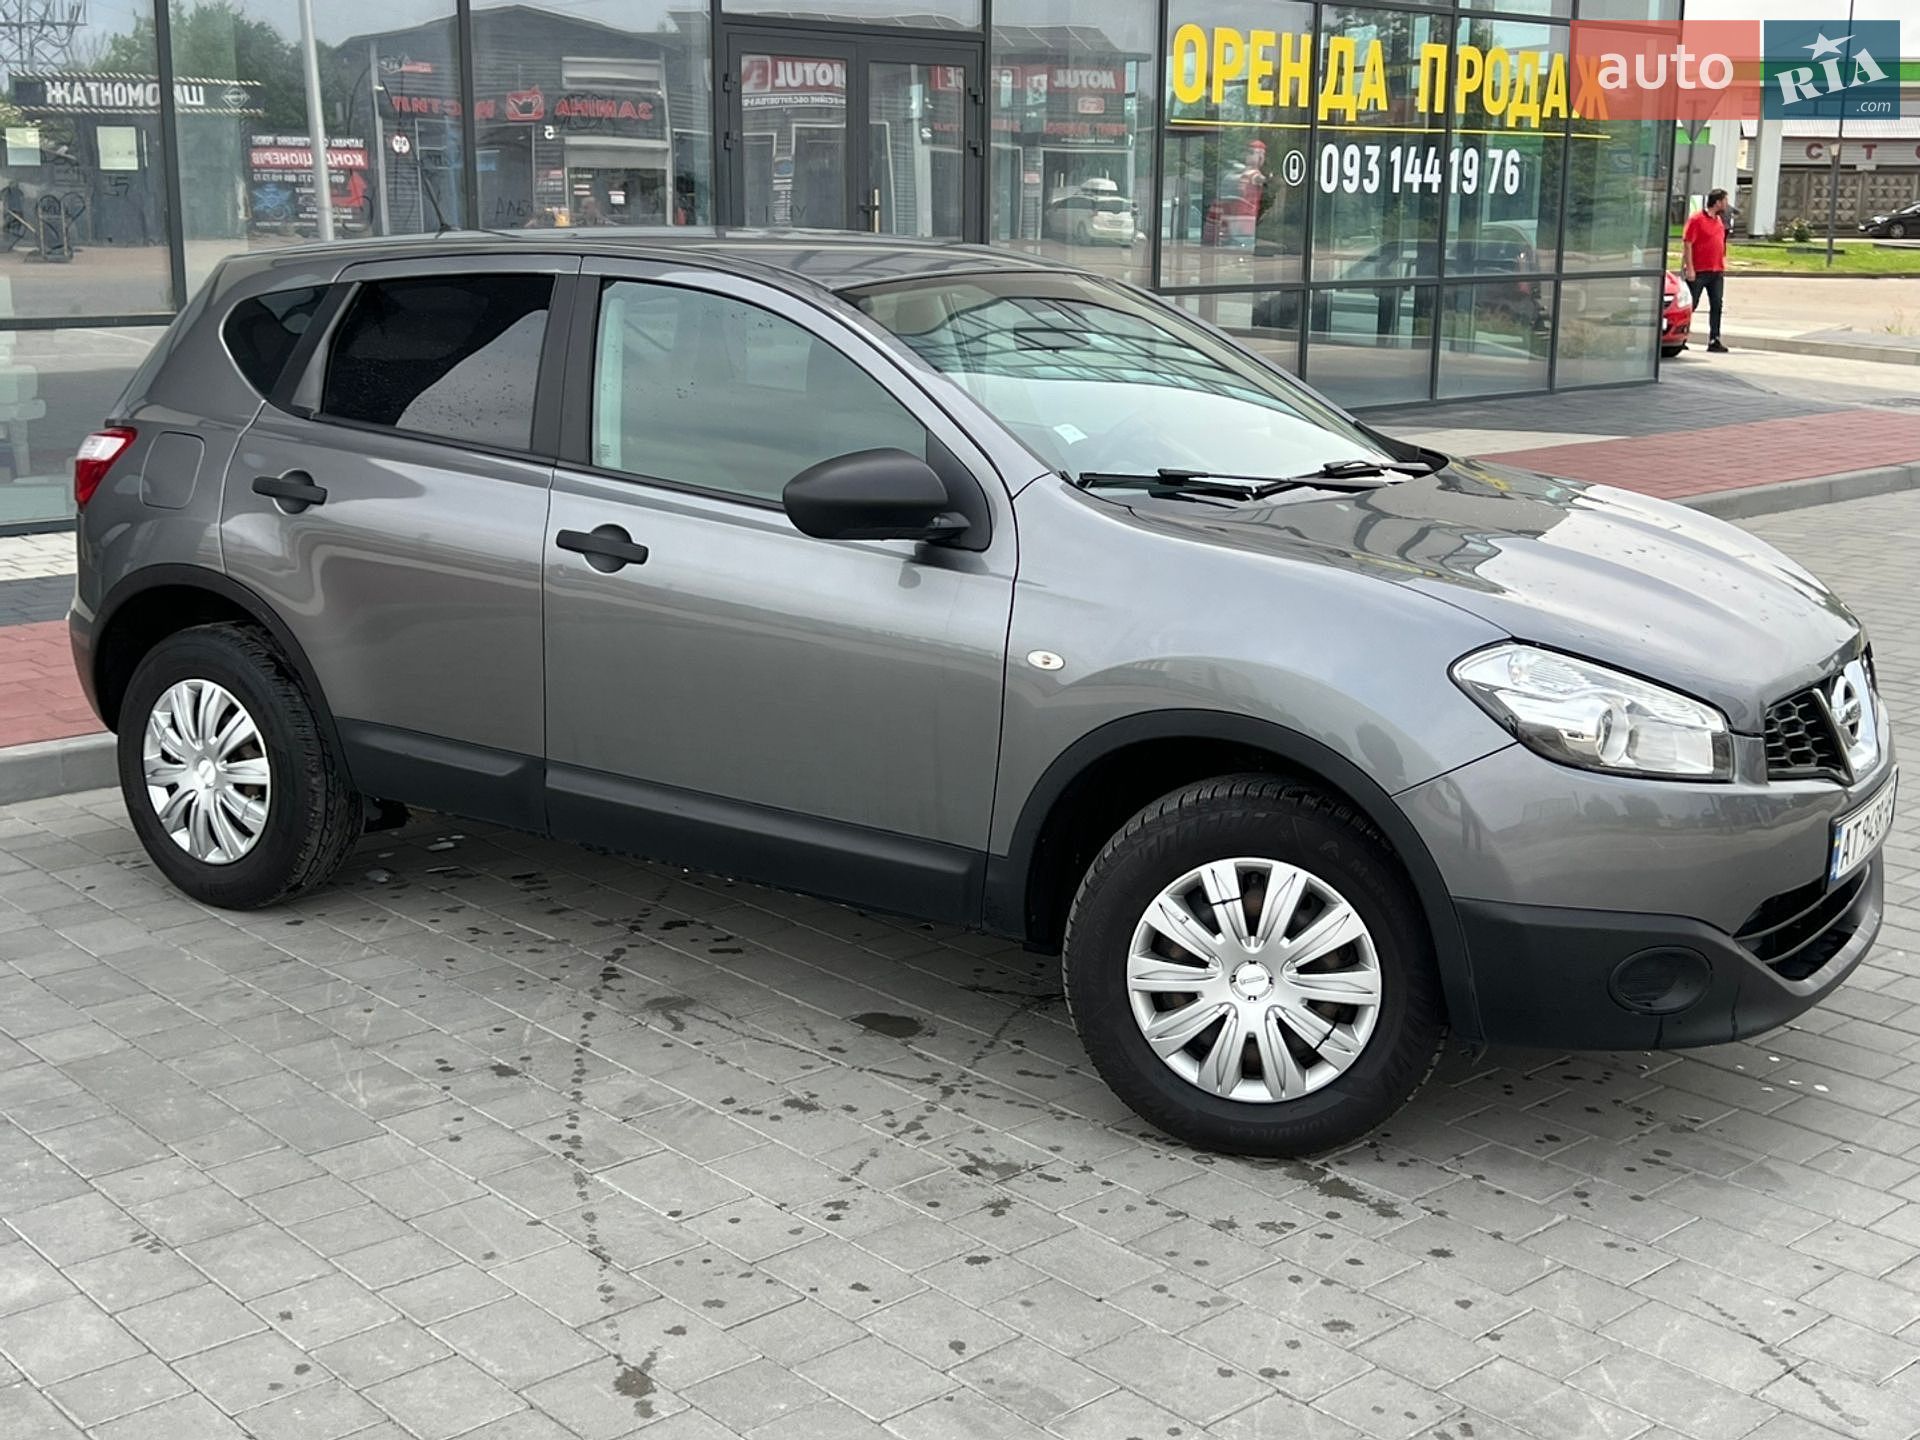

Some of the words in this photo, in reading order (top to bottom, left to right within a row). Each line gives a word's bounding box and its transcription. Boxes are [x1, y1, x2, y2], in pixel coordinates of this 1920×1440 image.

[1173, 23, 1389, 123] ОРЕНДА
[1417, 43, 1610, 129] ПРОДАЖ
[1320, 142, 1380, 194] 093
[1390, 145, 1441, 194] 144
[1450, 148, 1478, 195] 19
[1487, 148, 1521, 196] 76
